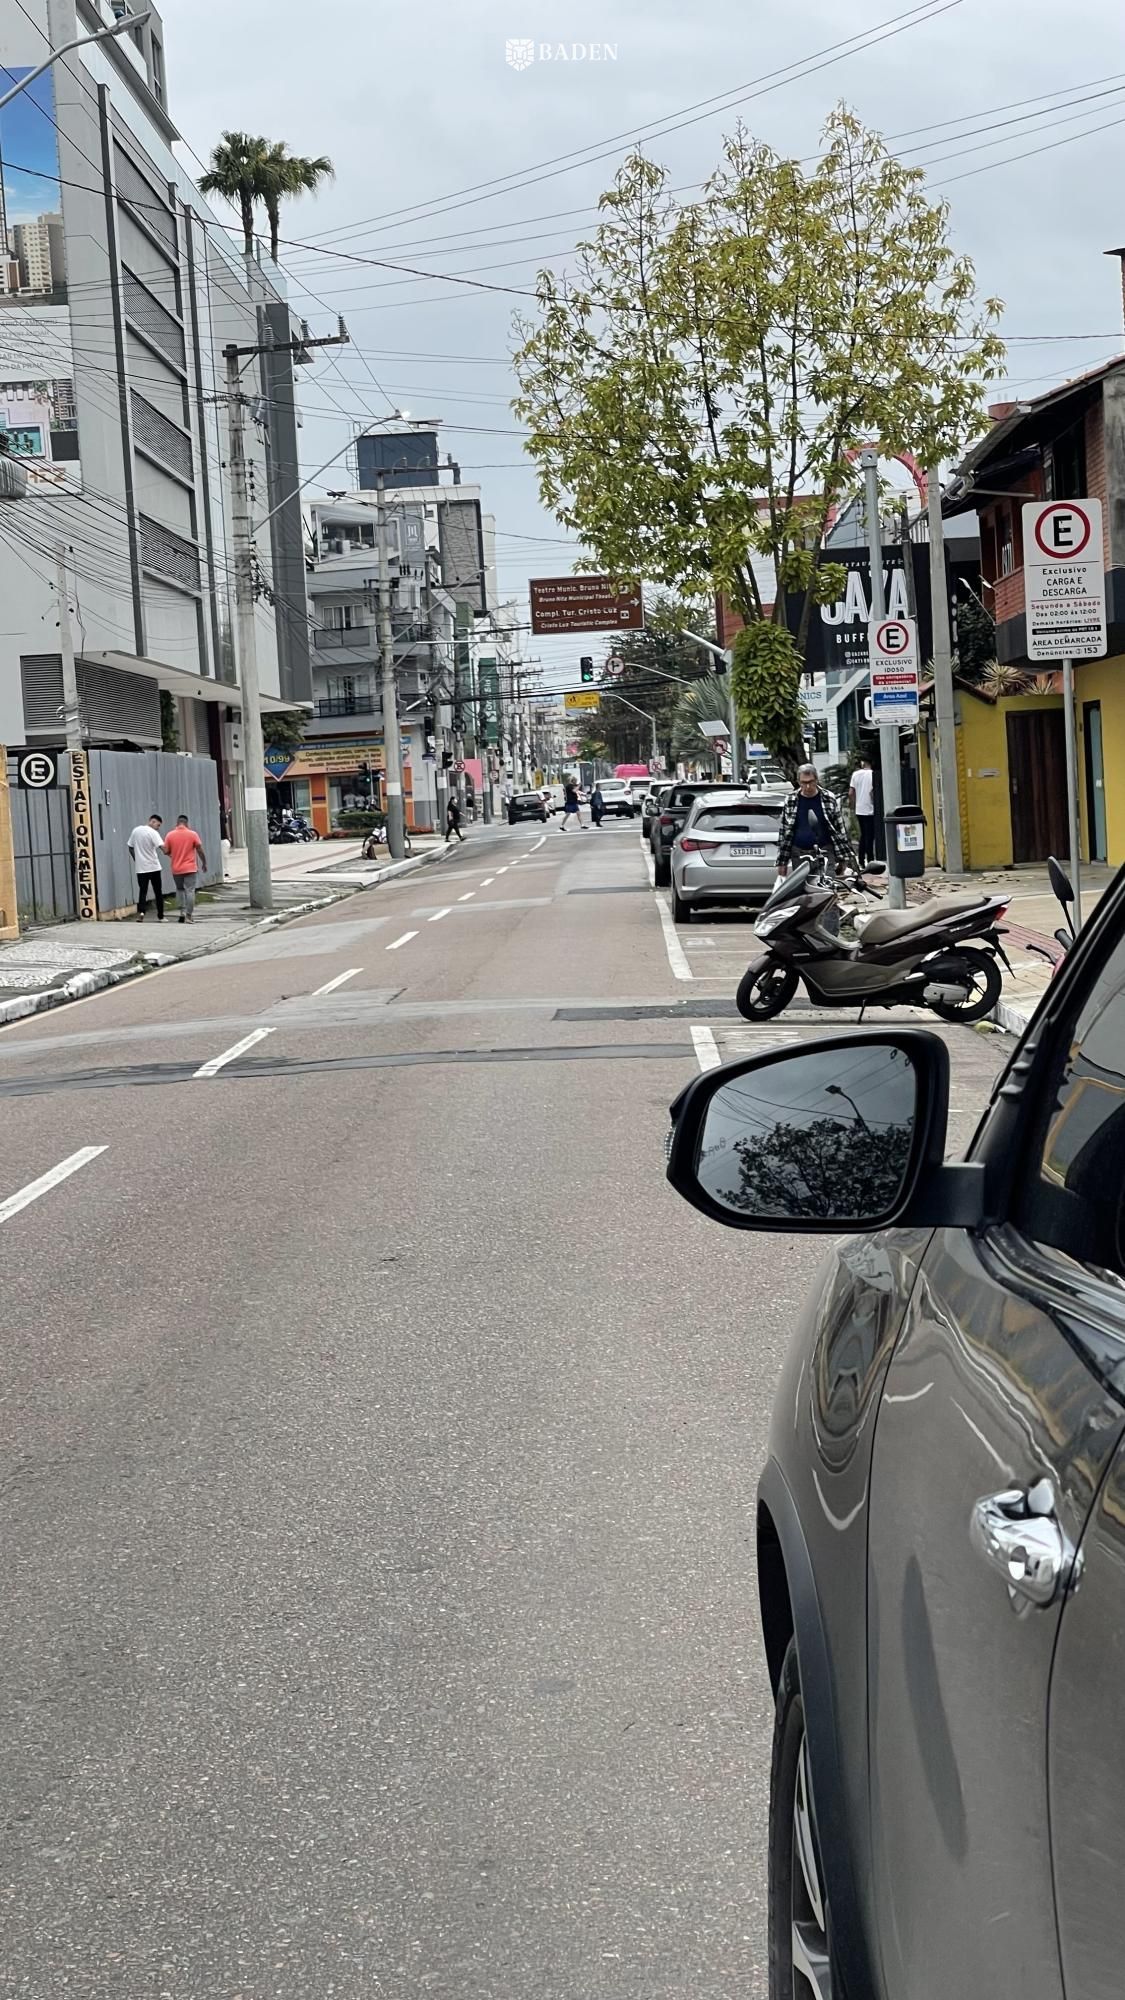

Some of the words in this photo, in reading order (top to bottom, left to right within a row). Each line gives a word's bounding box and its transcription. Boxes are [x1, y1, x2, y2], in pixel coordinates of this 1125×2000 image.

[1053, 515, 1073, 547] E
[1042, 567, 1087, 575] Exclusivo
[1046, 577, 1076, 586] CARGA
[1077, 576, 1083, 584] E
[580, 584, 600, 592] Bruno
[1042, 587, 1087, 597] DESCARGA
[535, 610, 561, 619] Compl.
[578, 608, 602, 616] Cristo
[603, 606, 618, 614] Luz
[836, 632, 868, 644] BUFF
[886, 628, 900, 648] E
[1054, 636, 1102, 645] DEMARCADA
[31, 761, 46, 780] E
[71, 753, 94, 919] ESTACIONAMENTO
